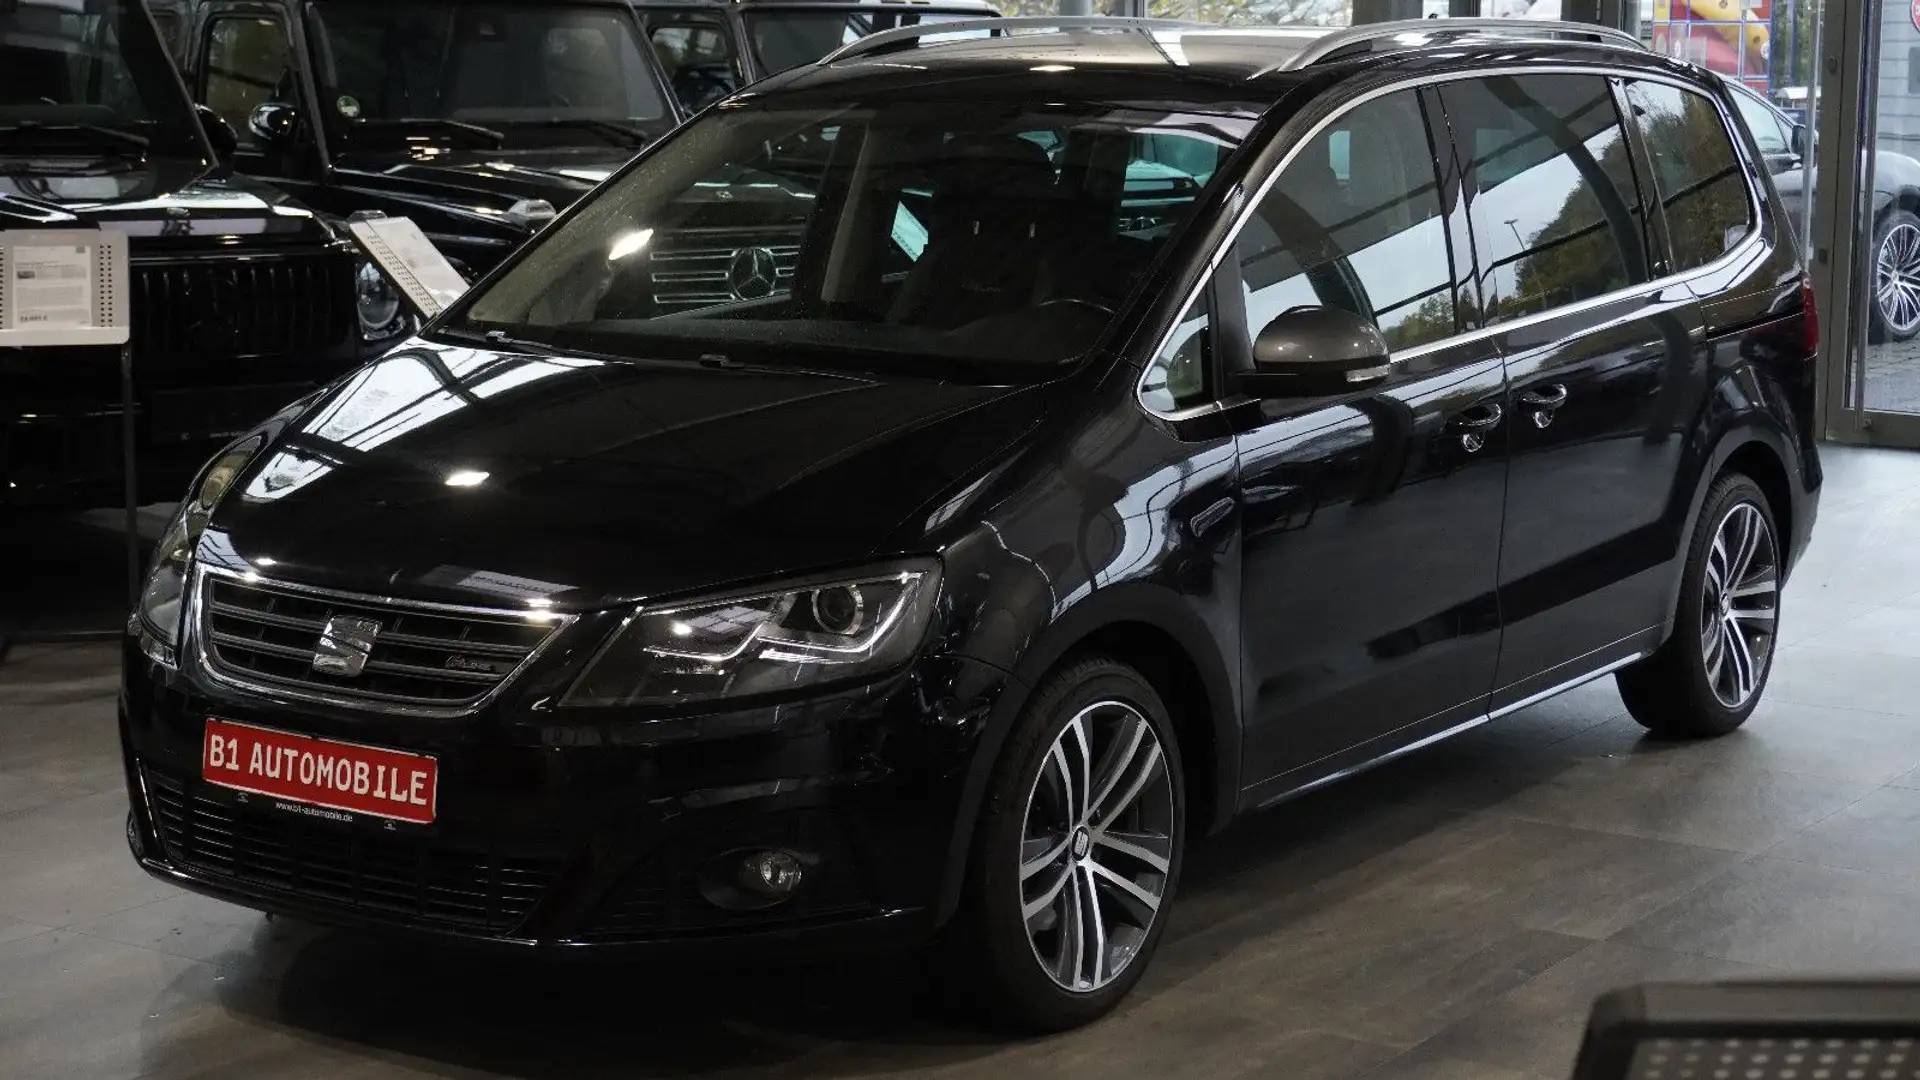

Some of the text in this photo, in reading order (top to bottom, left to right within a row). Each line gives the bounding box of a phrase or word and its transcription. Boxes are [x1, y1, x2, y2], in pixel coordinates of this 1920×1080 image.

[209, 734, 428, 806] B1 AUTOMOBILE
[275, 801, 354, 822] www.b1-automobile.de
